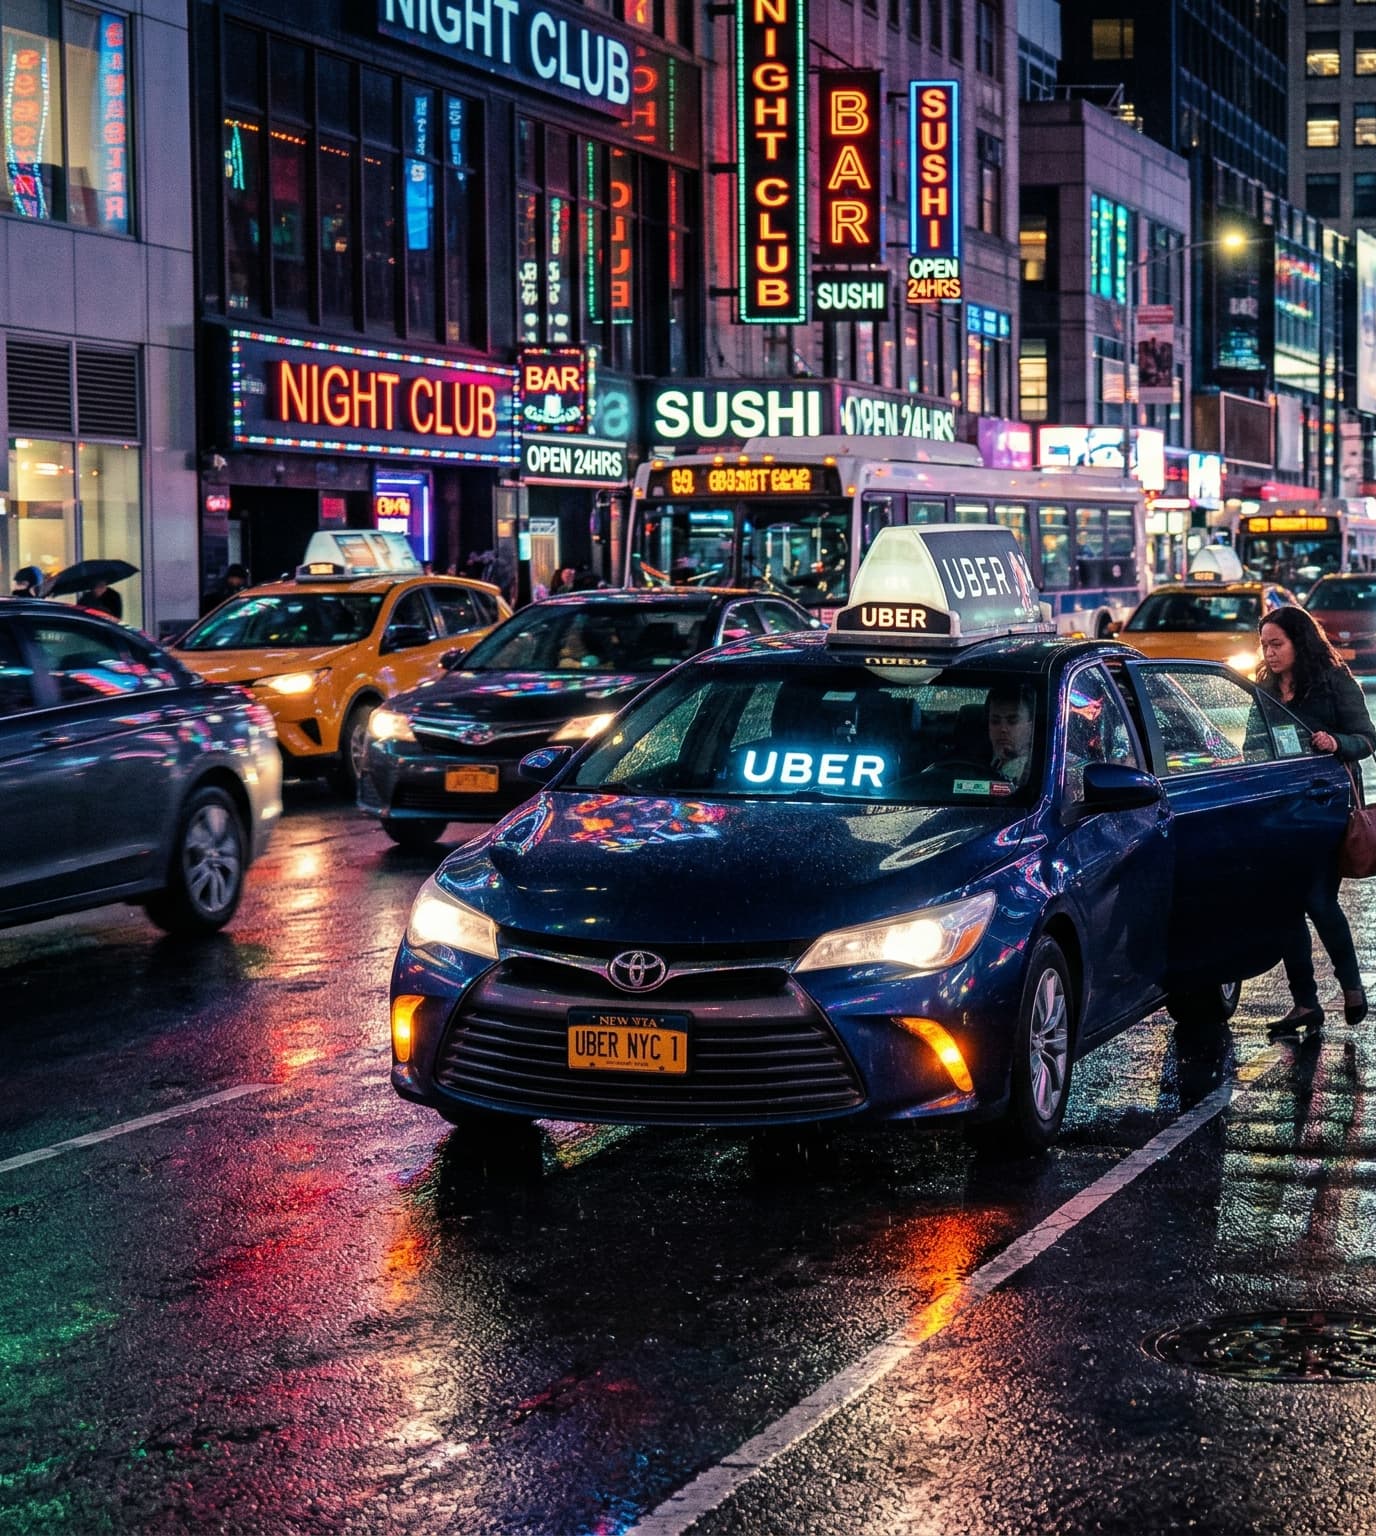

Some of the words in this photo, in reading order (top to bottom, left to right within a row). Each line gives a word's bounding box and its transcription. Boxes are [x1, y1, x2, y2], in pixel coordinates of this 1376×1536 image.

[530, 11, 630, 105] CLUB
[752, 0, 790, 161] NIGHT
[828, 91, 871, 244] BAR
[921, 89, 948, 248] SUSHI
[754, 177, 790, 307] CLUB
[907, 278, 961, 299] 24HRS
[909, 258, 958, 279] OPEN
[817, 282, 884, 310] SUSHI
[279, 359, 400, 431] NIGHT
[409, 376, 498, 439] CLUB
[525, 366, 581, 392] BAR
[655, 390, 820, 438] SUSHI
[844, 396, 898, 436] OPEN
[526, 445, 573, 475] OPEN
[574, 447, 623, 478] 24HRS
[942, 556, 1011, 599] UBER
[861, 607, 927, 628] UBER
[743, 750, 885, 787] UBER
[576, 1030, 618, 1057] UBER
[628, 1033, 661, 1060] NYC
[671, 1036, 677, 1061] 1
